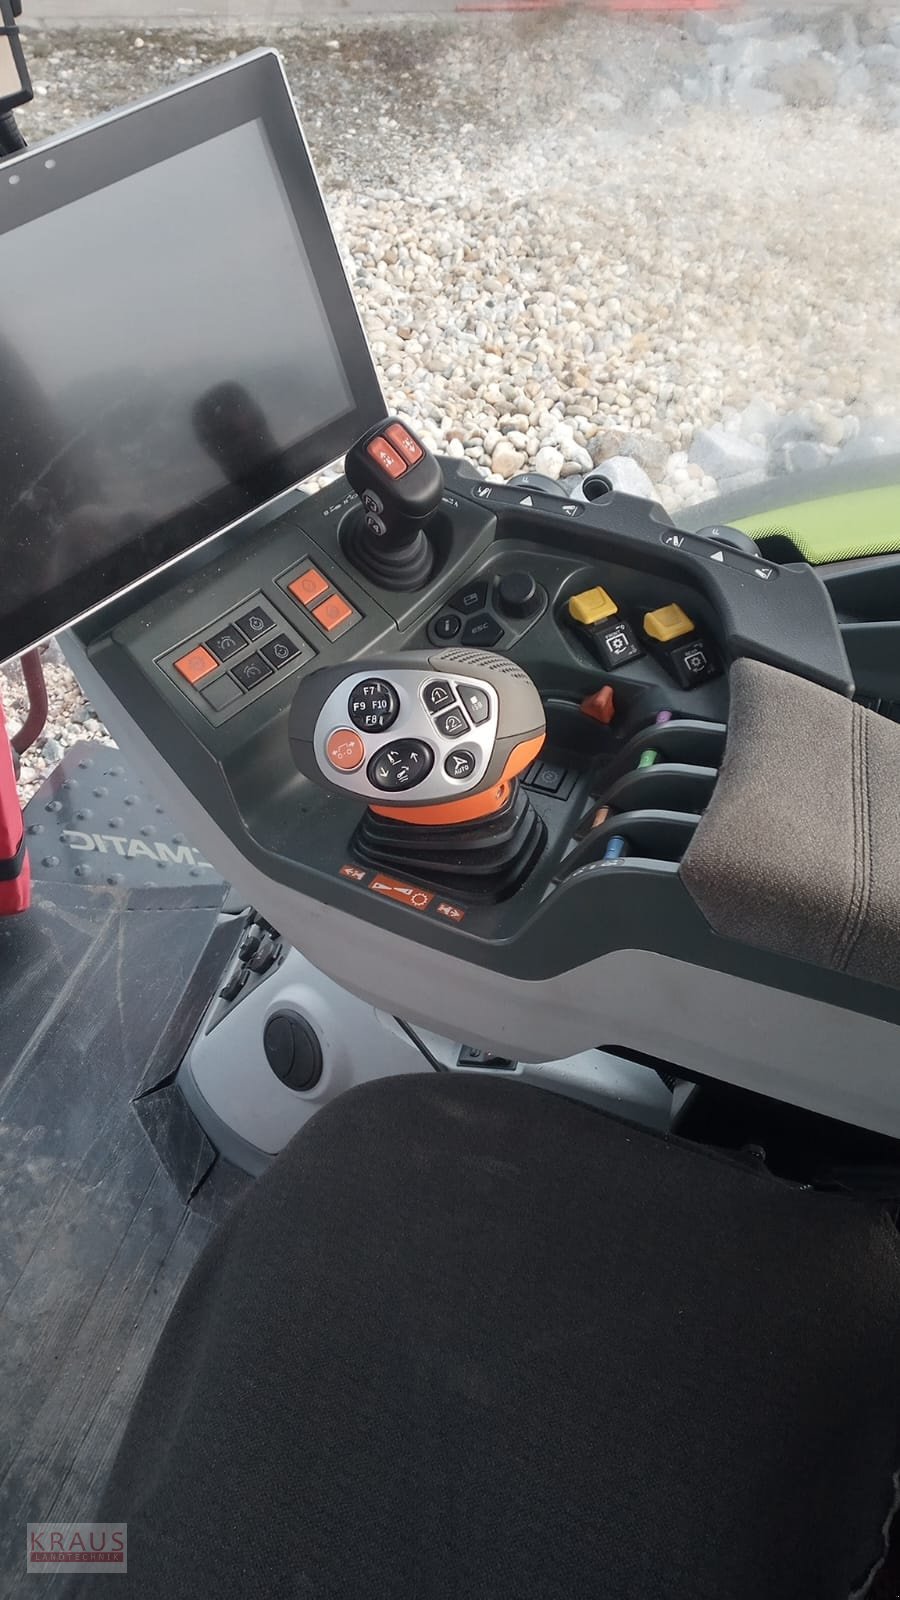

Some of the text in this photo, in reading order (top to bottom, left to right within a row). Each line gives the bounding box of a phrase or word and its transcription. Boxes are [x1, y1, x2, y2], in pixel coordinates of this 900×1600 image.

[363, 686, 375, 696] F7
[353, 701, 366, 712] F9
[372, 699, 387, 709] F10
[365, 714, 377, 725] F8
[454, 765, 469, 775] AUTO
